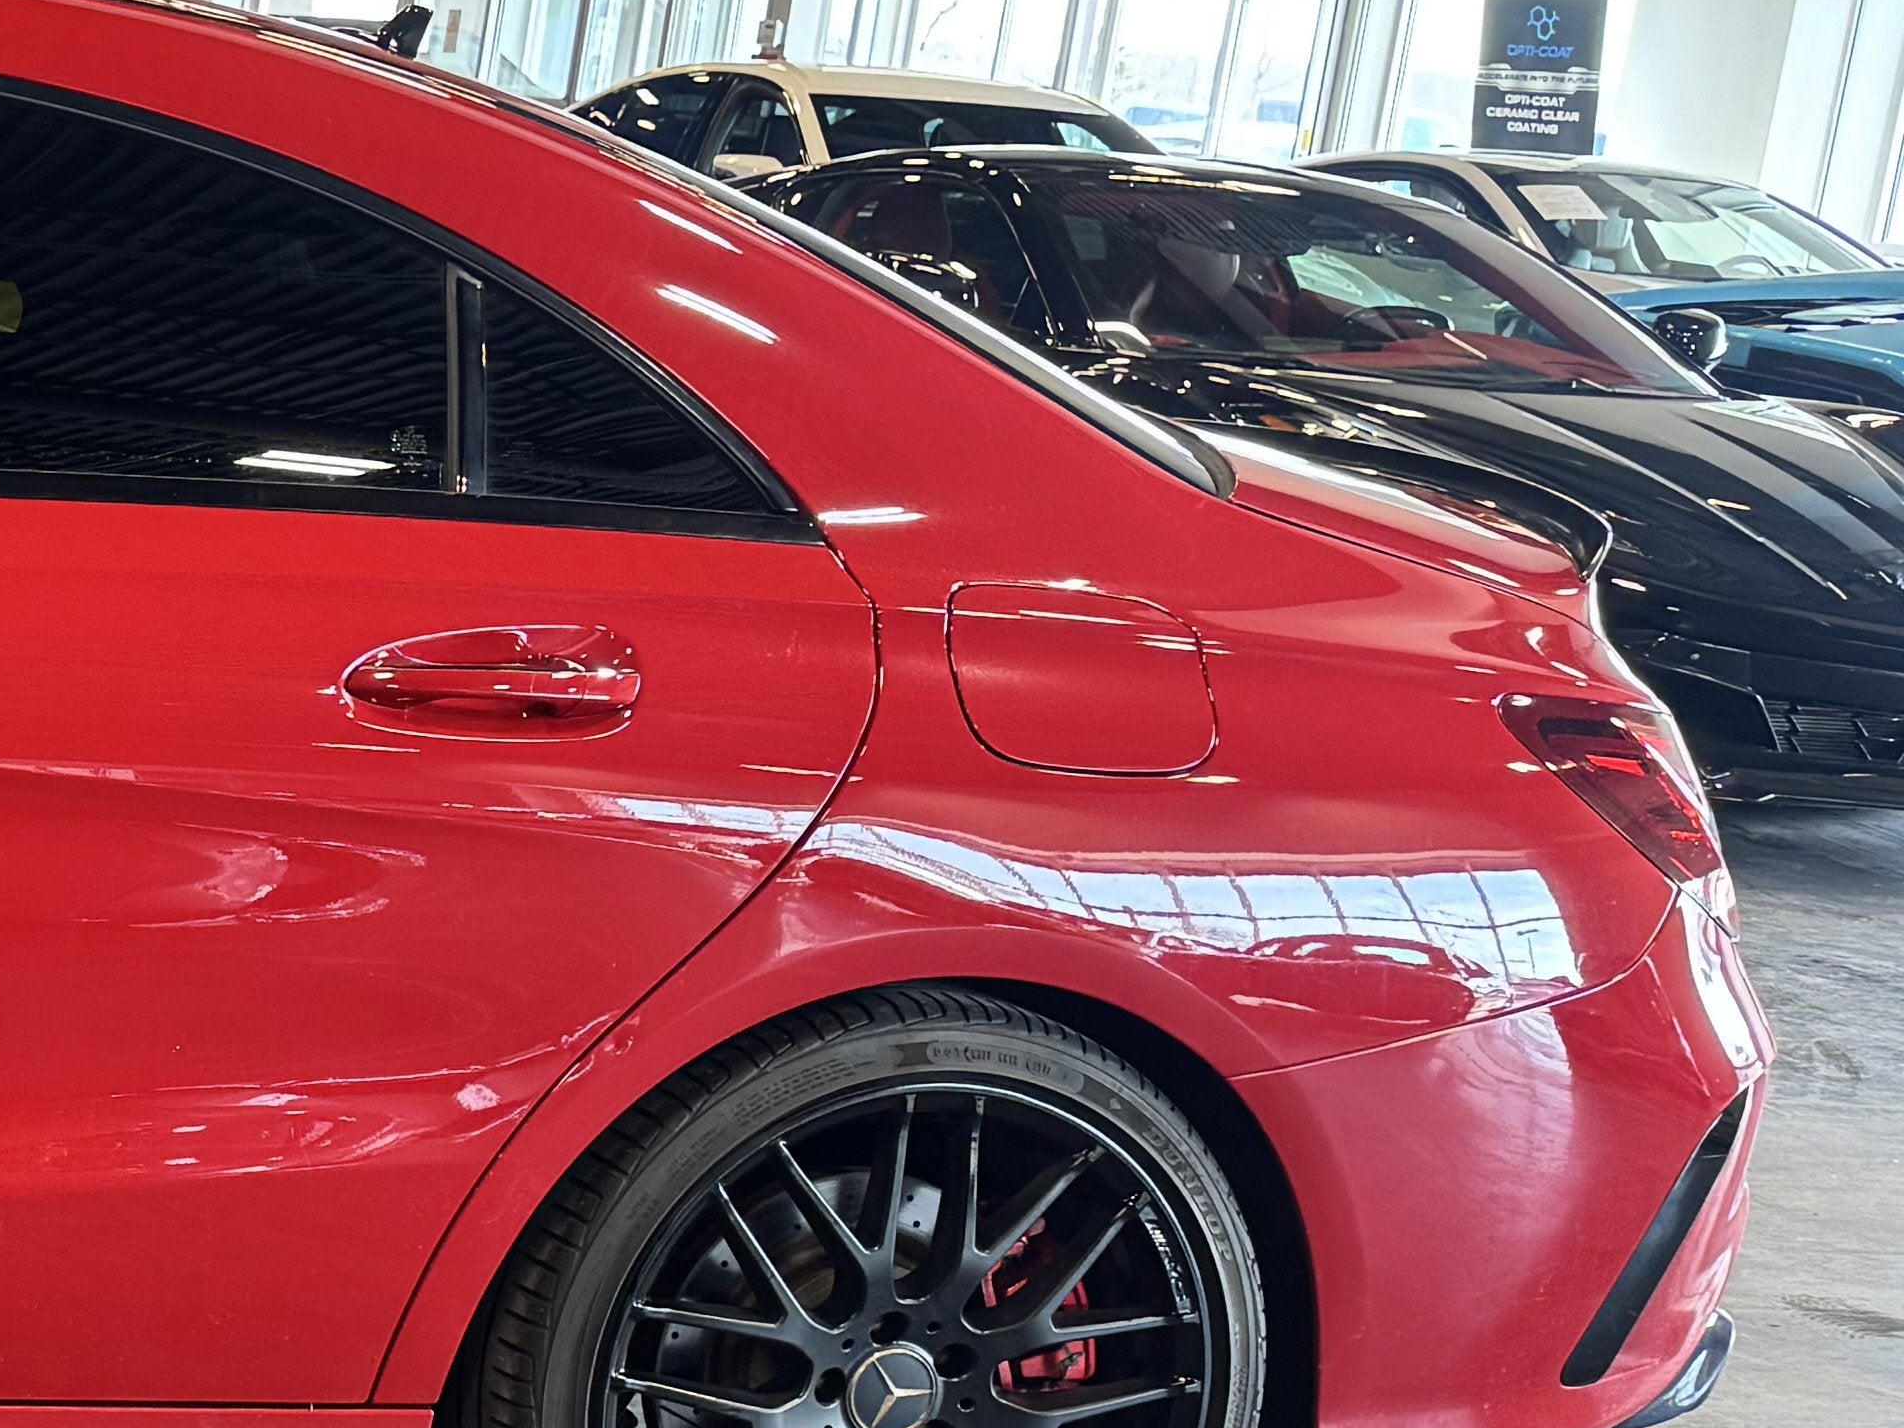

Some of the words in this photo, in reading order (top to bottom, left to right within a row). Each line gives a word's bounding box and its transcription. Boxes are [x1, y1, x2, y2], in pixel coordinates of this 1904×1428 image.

[1507, 44, 1575, 58] OPTI-COAT
[1505, 94, 1566, 107] OPTI-COAT
[1486, 107, 1539, 119] CERAMIC
[1541, 110, 1580, 122] CLEAR
[1507, 121, 1559, 135] COATING
[1142, 1125, 1234, 1262] DUNLOP
